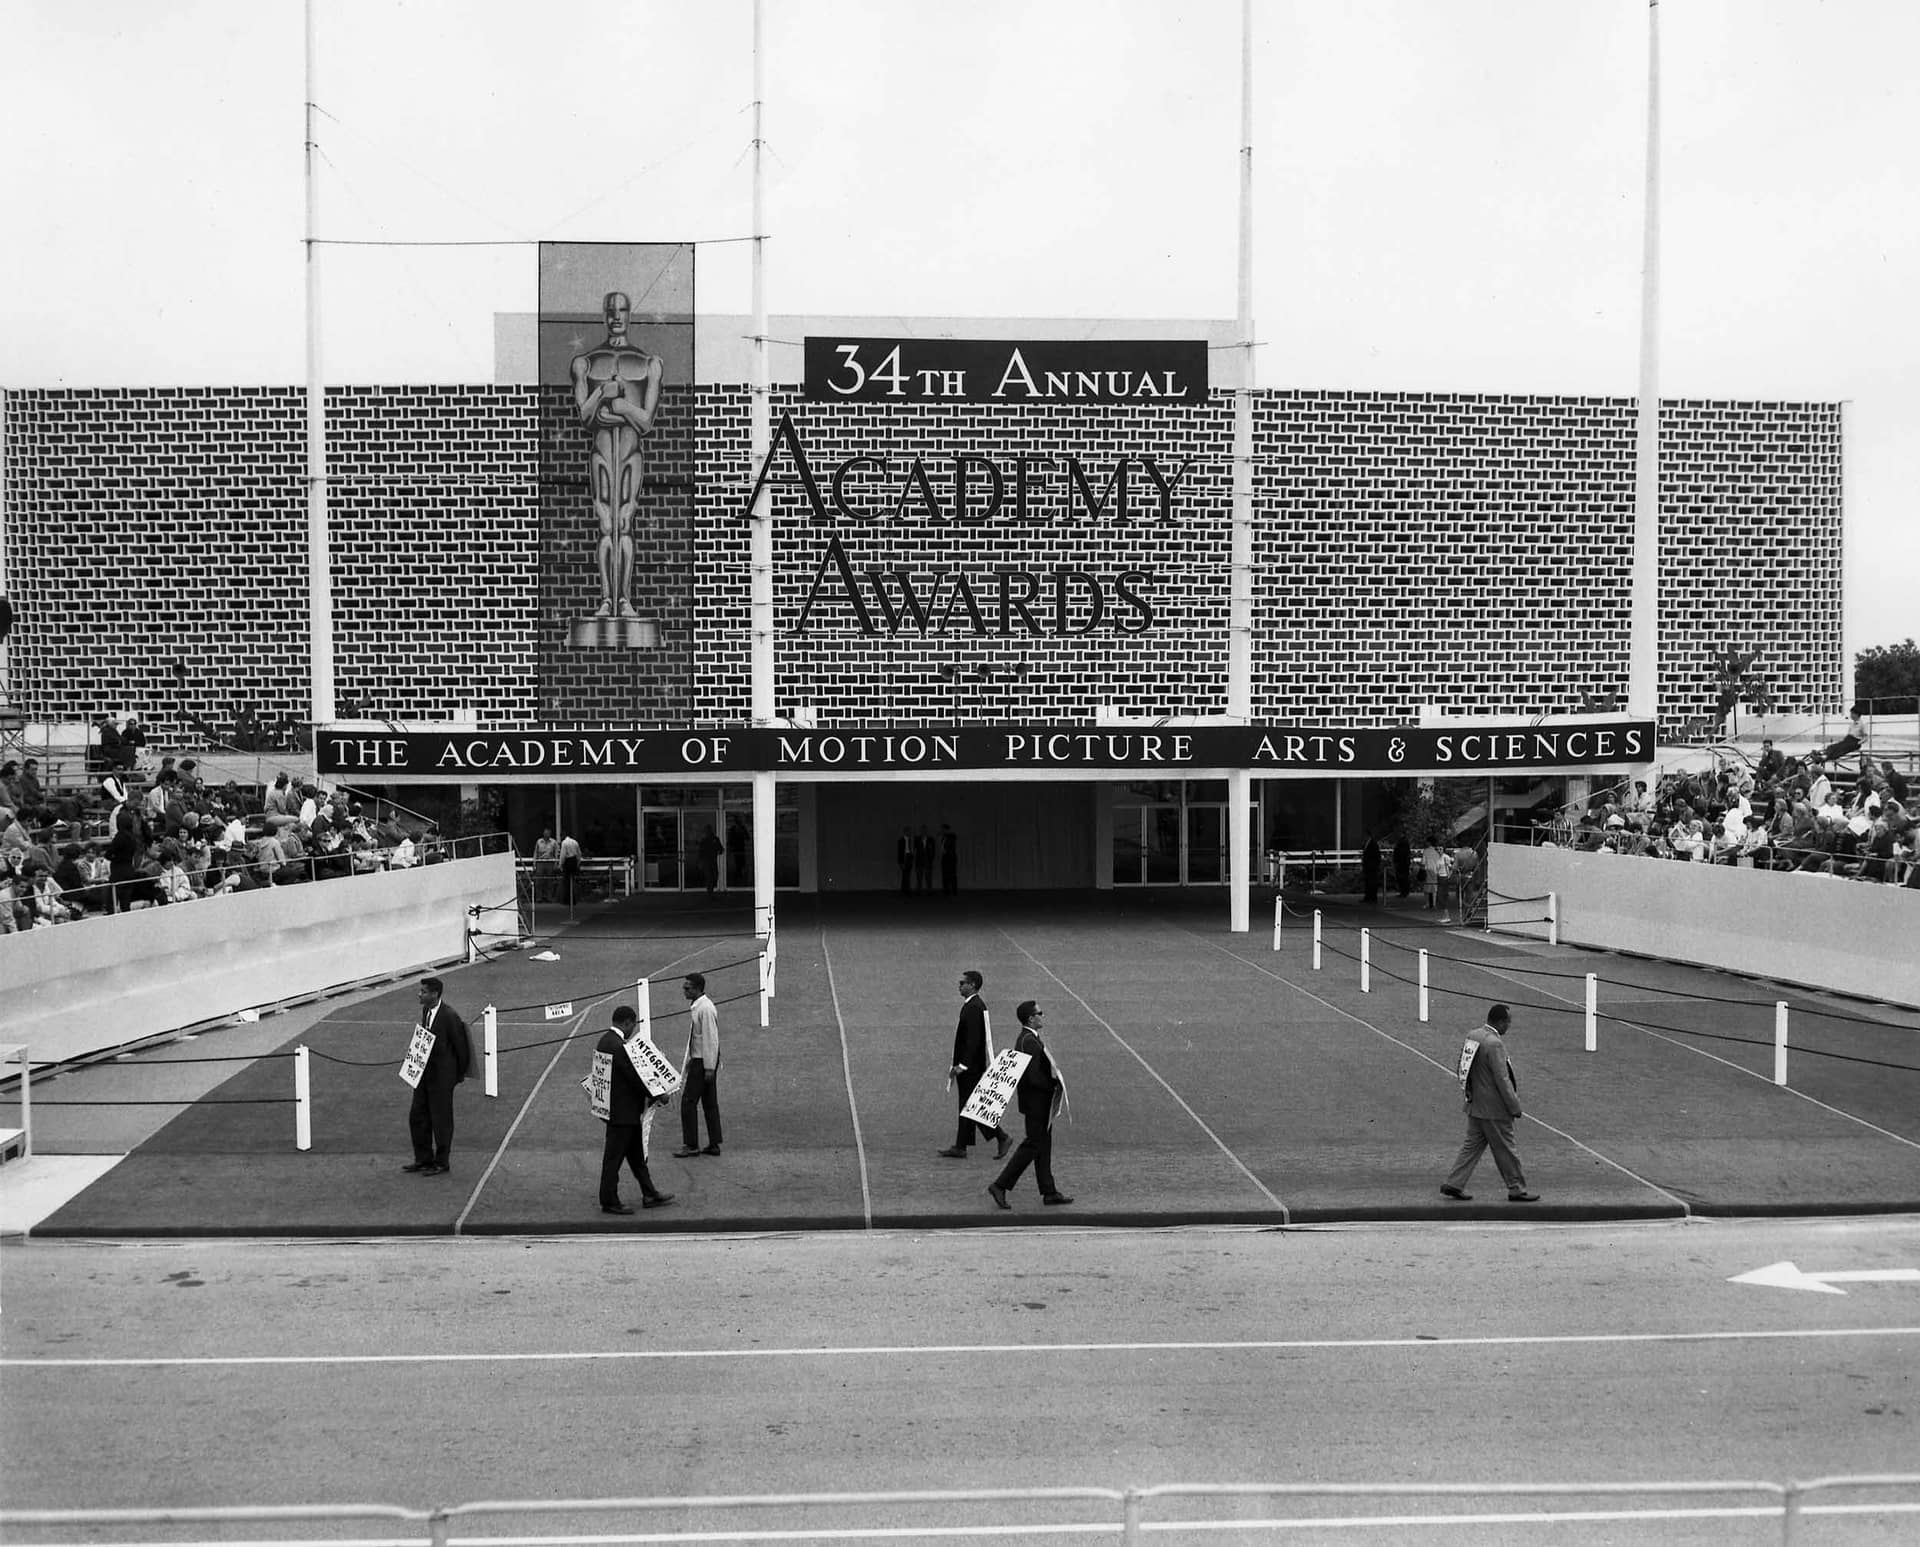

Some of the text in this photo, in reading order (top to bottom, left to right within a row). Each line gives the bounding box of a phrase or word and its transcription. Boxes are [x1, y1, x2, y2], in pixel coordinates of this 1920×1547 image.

[827, 344, 966, 397] 34TH
[331, 729, 1642, 767] THE ACADEMY OF MOTION PICTURE ARTS & SCIENCES
[635, 1038, 677, 1084] INTEGRATED
[987, 1068, 1018, 1088] AMERICA
[990, 1081, 999, 1089] IS
